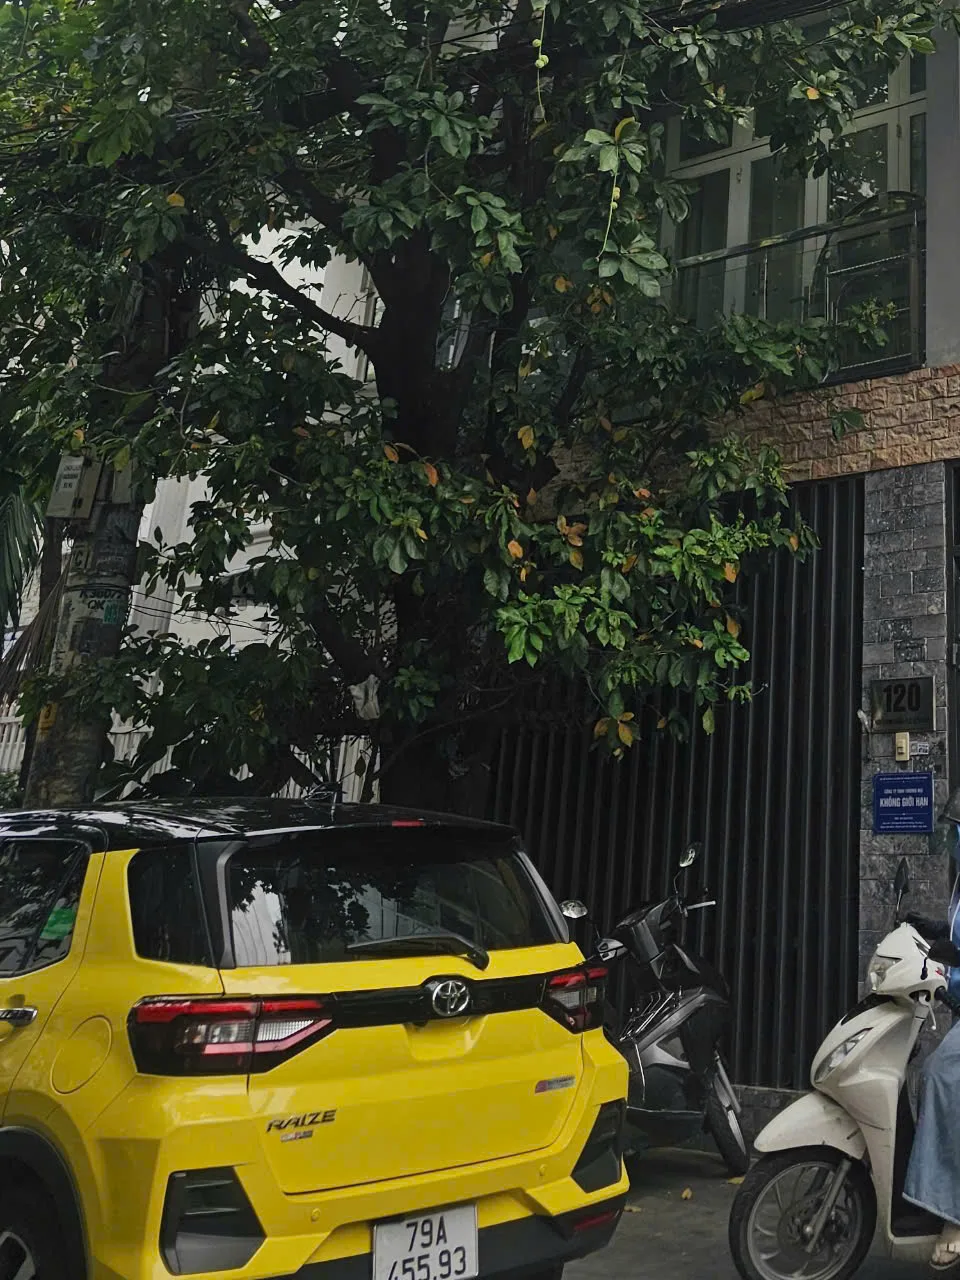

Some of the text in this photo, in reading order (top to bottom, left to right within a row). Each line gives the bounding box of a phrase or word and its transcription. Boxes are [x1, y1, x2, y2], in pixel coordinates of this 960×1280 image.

[883, 682, 921, 713] 120
[915, 797, 928, 808] HẠN
[266, 1109, 336, 1133] RAIZE
[406, 1216, 448, 1252] 79A
